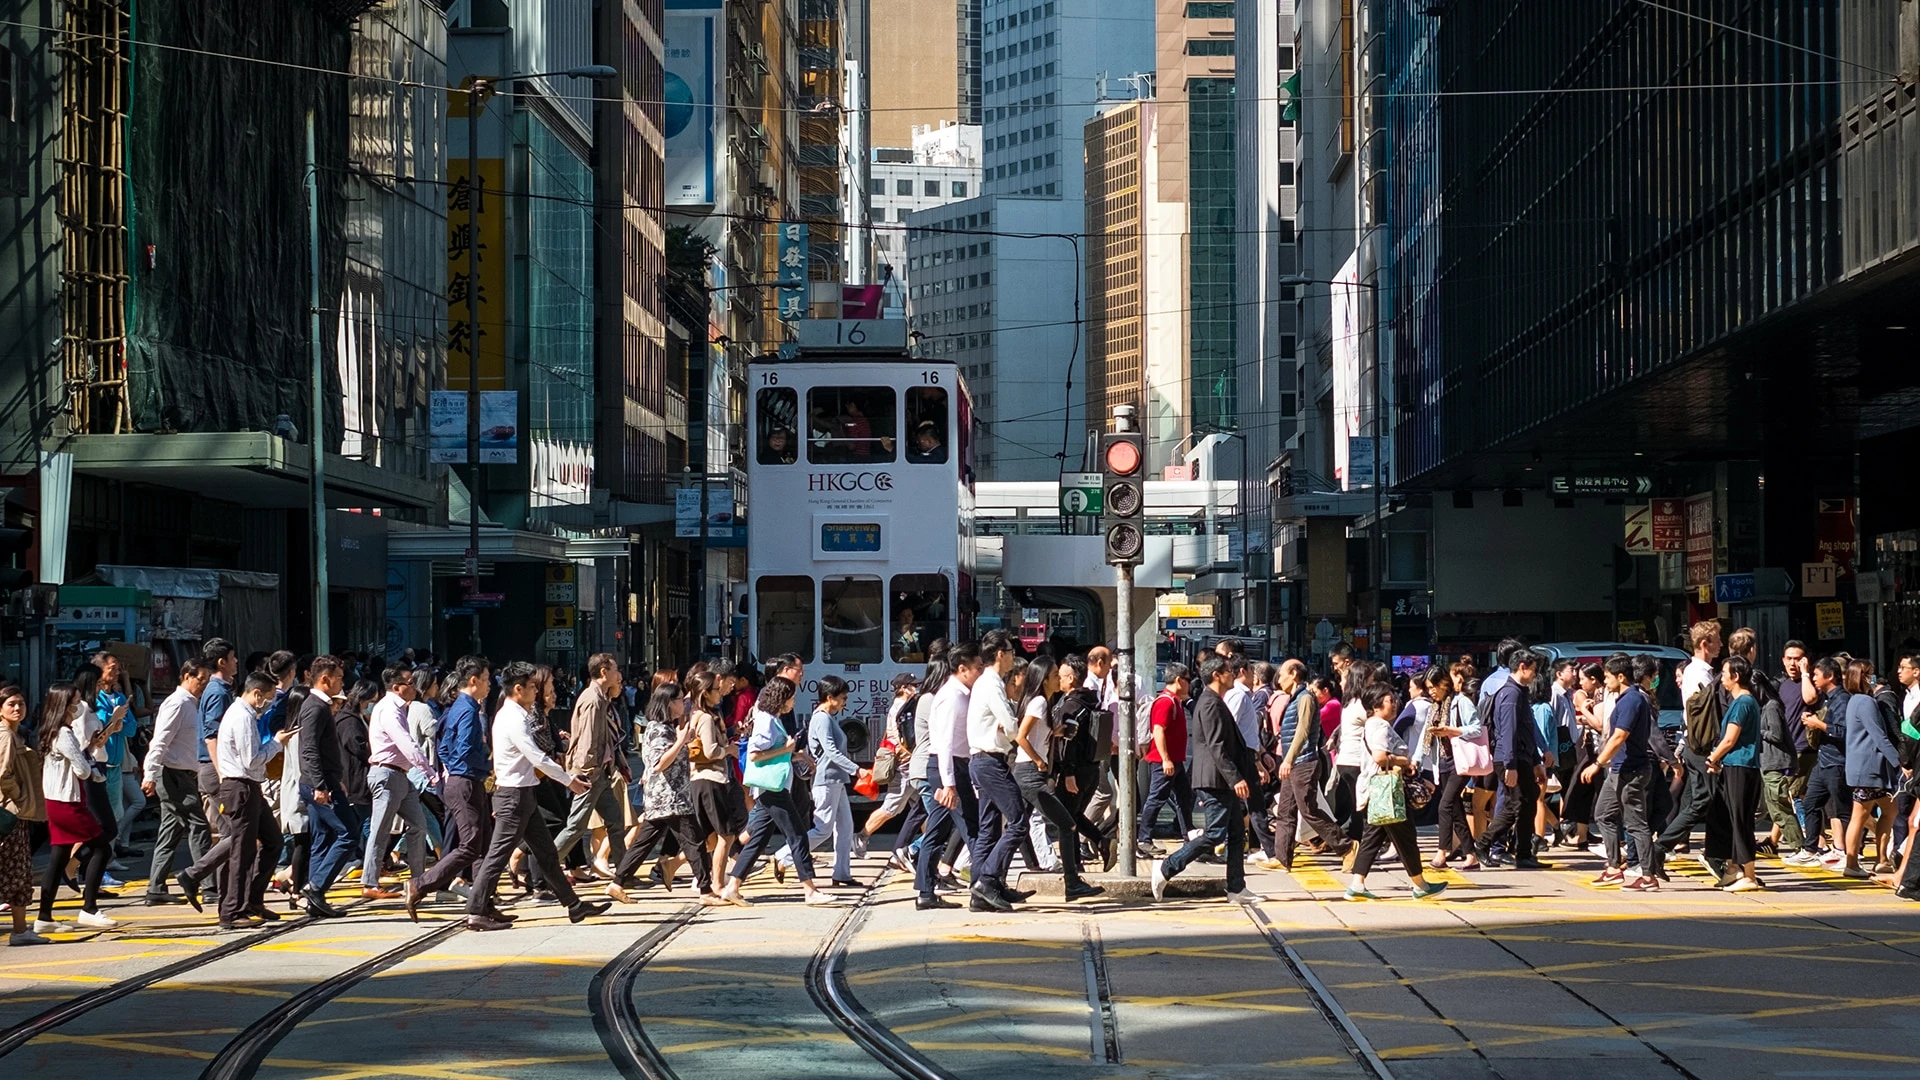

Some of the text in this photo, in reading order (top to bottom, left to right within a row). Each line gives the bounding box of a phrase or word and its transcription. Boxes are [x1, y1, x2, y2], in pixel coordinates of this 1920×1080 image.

[836, 321, 866, 345] 16
[761, 372, 779, 386] 16
[921, 371, 940, 384] 16
[1818, 539, 1833, 553] Ang
[1833, 540, 1850, 553] shop
[1805, 567, 1833, 583] FT
[848, 679, 865, 693] OF
[870, 679, 897, 693] BUS
